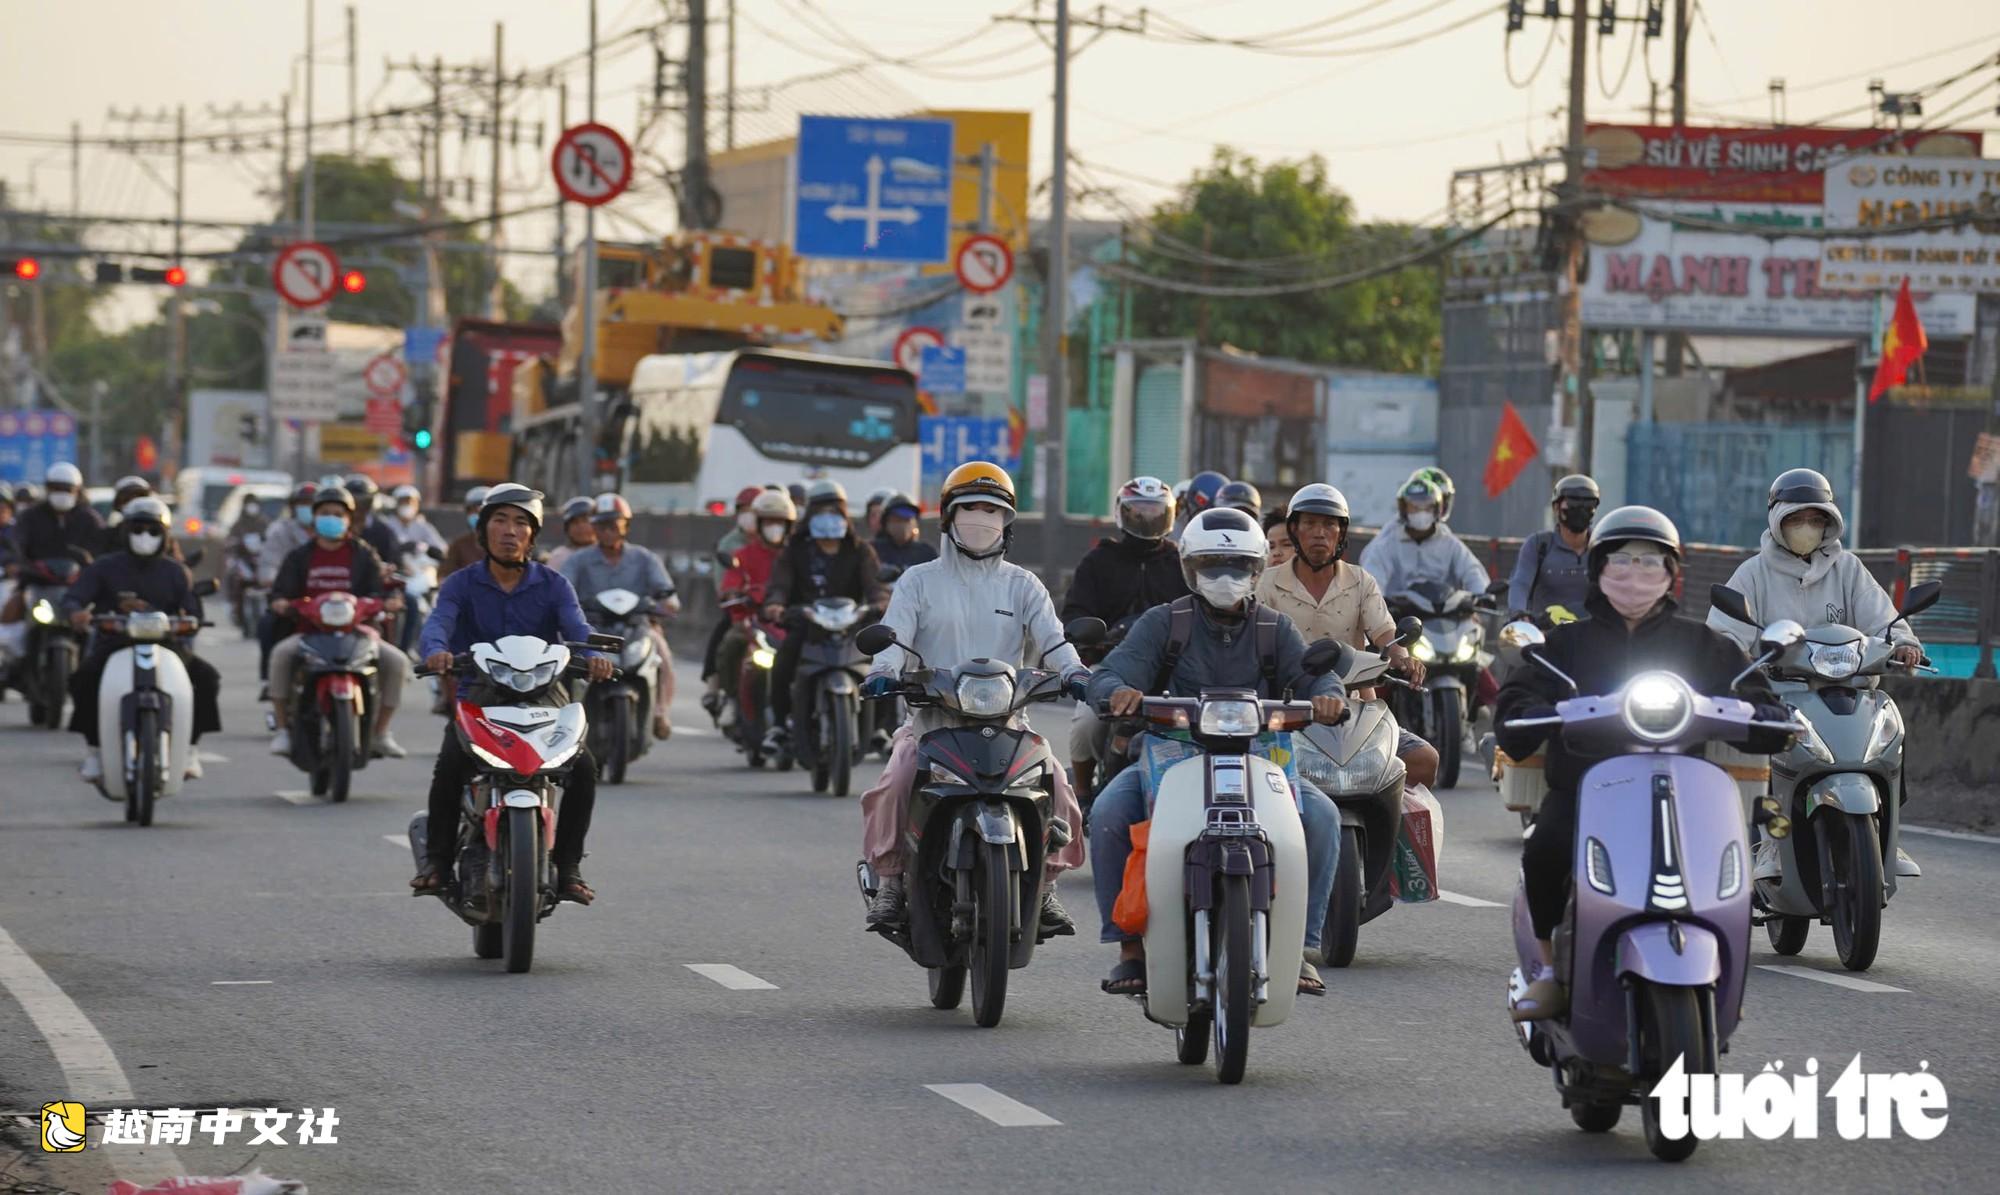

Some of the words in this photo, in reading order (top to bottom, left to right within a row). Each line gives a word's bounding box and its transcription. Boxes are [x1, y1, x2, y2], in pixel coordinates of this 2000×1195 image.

[1648, 133, 1681, 167] SỨ
[1686, 133, 1721, 174] VỆ
[1727, 140, 1788, 171] SINH
[1883, 164, 1940, 187] CÔNG
[1948, 170, 1974, 187] TY
[1605, 253, 1750, 303] MẠNH
[1408, 878, 1426, 892] 3
